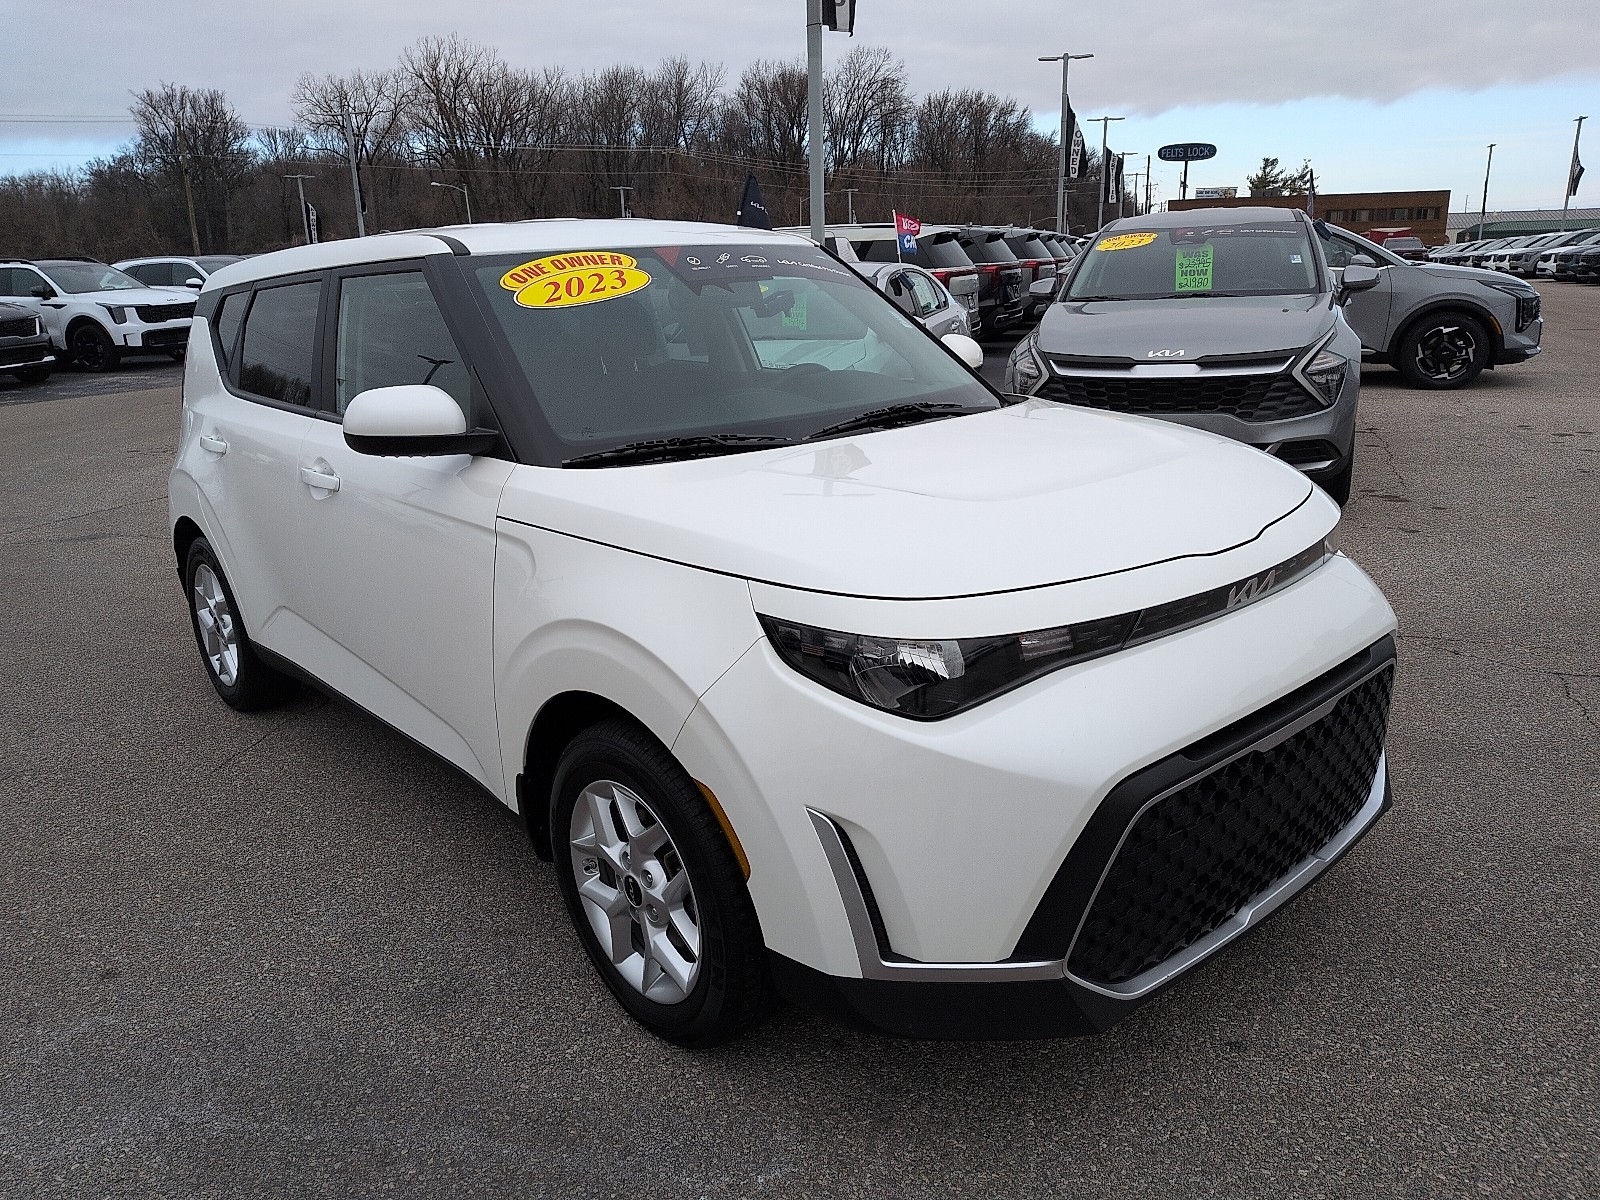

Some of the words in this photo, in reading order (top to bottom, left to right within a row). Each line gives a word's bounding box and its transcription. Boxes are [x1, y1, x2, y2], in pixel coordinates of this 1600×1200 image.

[1070, 129, 1083, 175] OWNED
[1161, 148, 1184, 158] FELTS
[1187, 146, 1211, 157] LOCK
[1182, 250, 1209, 259] WAS
[508, 262, 551, 284] ONE
[550, 254, 623, 271] OWNER
[1180, 269, 1209, 278] NOW
[543, 269, 627, 304] 2023
[1148, 350, 1185, 358] KIA
[1226, 569, 1276, 609] KIA
